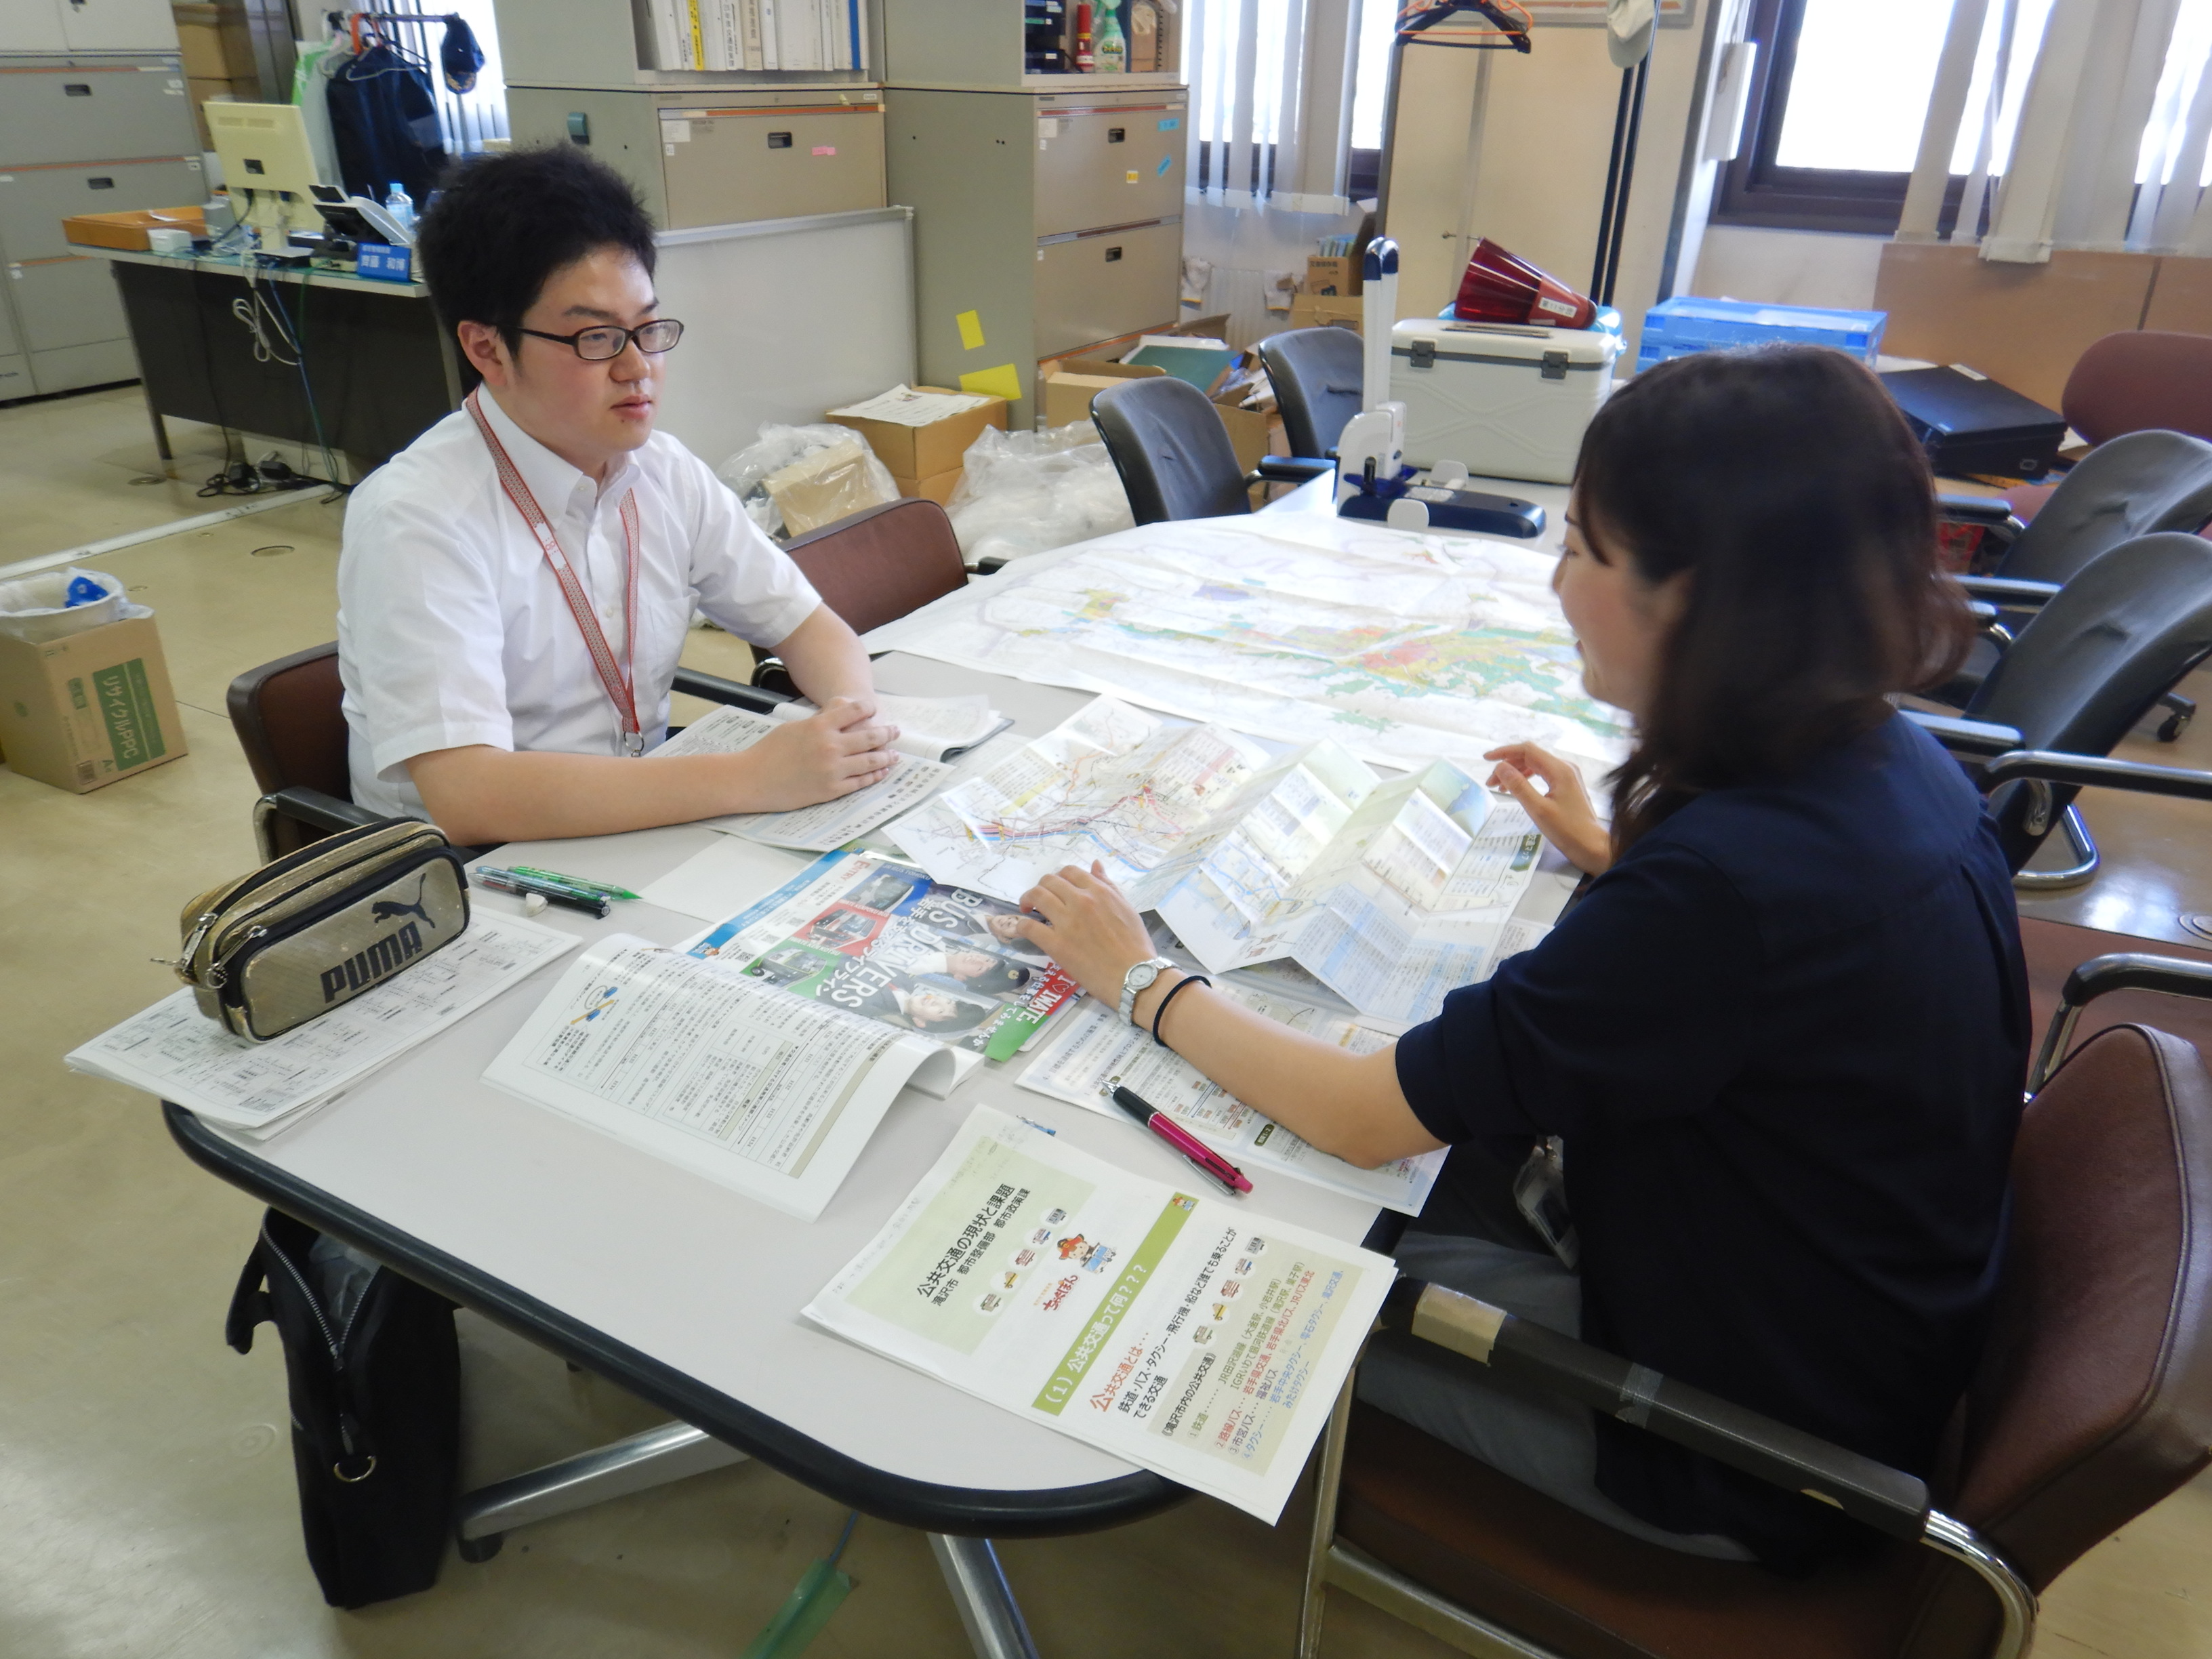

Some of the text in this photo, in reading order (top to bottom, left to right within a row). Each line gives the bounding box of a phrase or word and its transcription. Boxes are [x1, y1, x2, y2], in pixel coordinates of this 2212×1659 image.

[839, 859, 872, 882] ENTRY
[925, 887, 983, 933] BUS
[319, 921, 424, 1004] PUMA
[810, 896, 938, 996] 岩手を支えるライフライン
[827, 924, 942, 1010] DRIVERS
[914, 1180, 1016, 1300] 公共交通の現状と課題
[930, 1185, 1031, 1309] 滝沢市 都市整備部 都市政策課
[1116, 1227, 1238, 1414] 鉄道・バス・タクシー・飛行機・船など誰でも乗ることが
[1132, 1372, 1168, 1422] できる交通
[1254, 1366, 1279, 1401] 福祉バス
[1282, 1359, 1312, 1409] みたけタクシー
